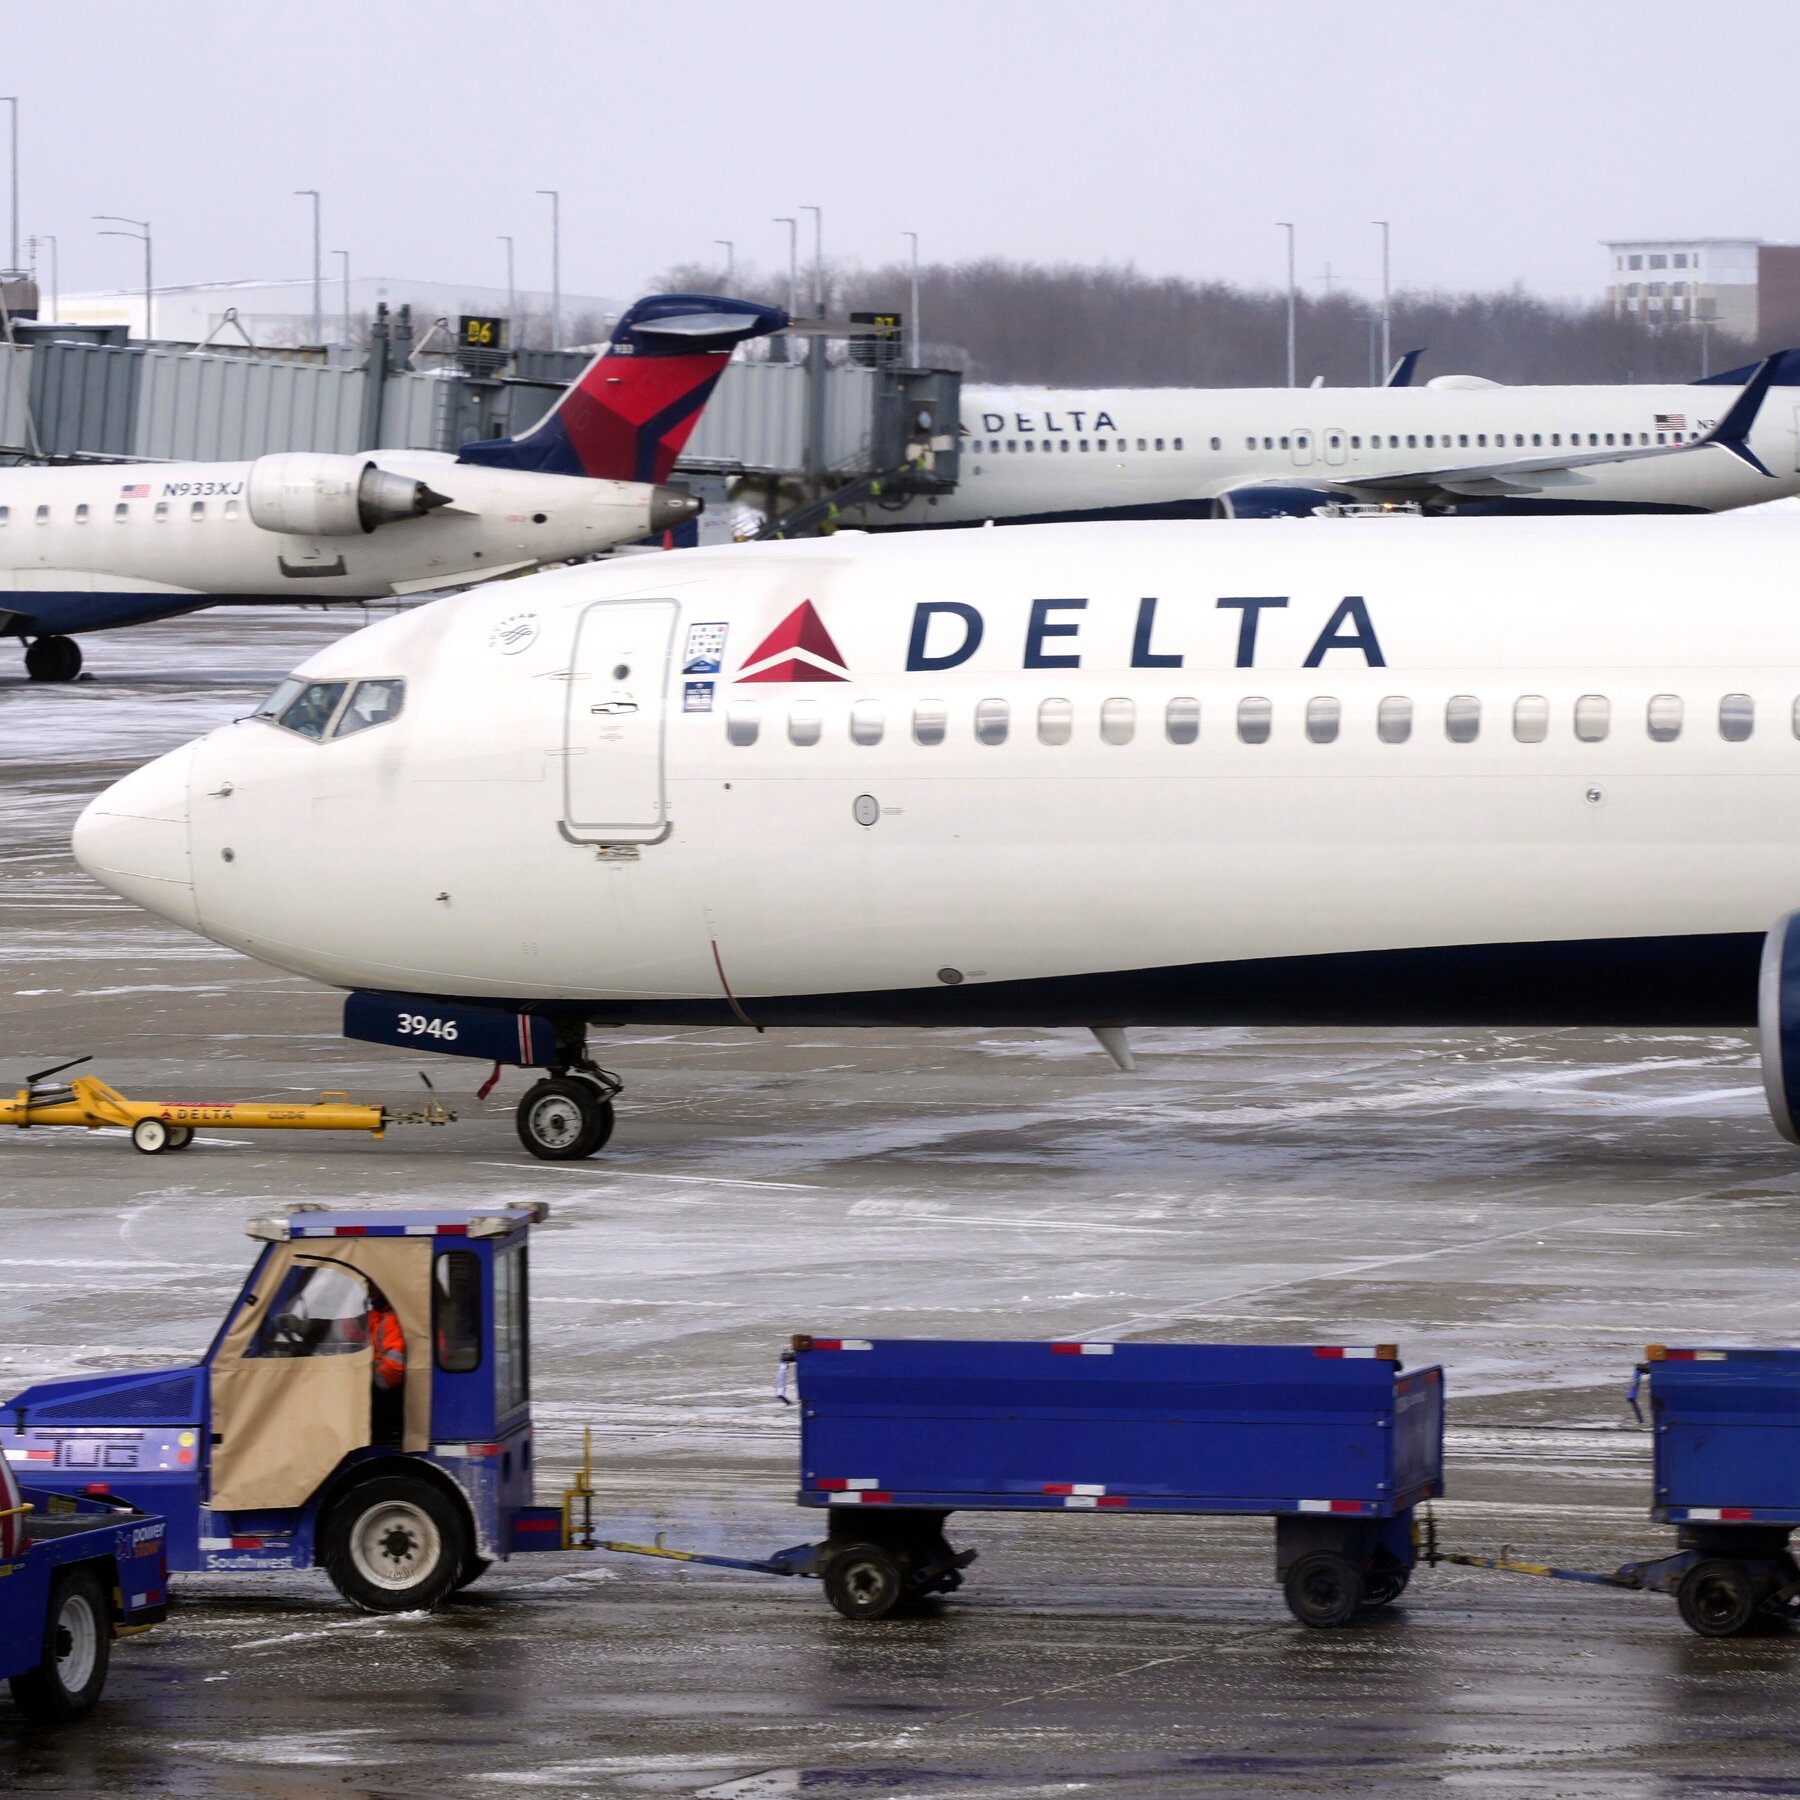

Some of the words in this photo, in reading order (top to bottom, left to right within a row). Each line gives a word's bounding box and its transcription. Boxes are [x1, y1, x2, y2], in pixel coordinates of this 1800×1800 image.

[467, 320, 492, 343] D6
[982, 411, 1117, 432] DELTA
[162, 482, 244, 496] N933XJ
[904, 596, 1387, 671] DELTA
[397, 1013, 459, 1040] 3946
[177, 1109, 233, 1120] DELTA
[35, 1432, 144, 1467] TUG
[131, 1523, 166, 1548] power
[206, 1554, 296, 1569] Southwest
